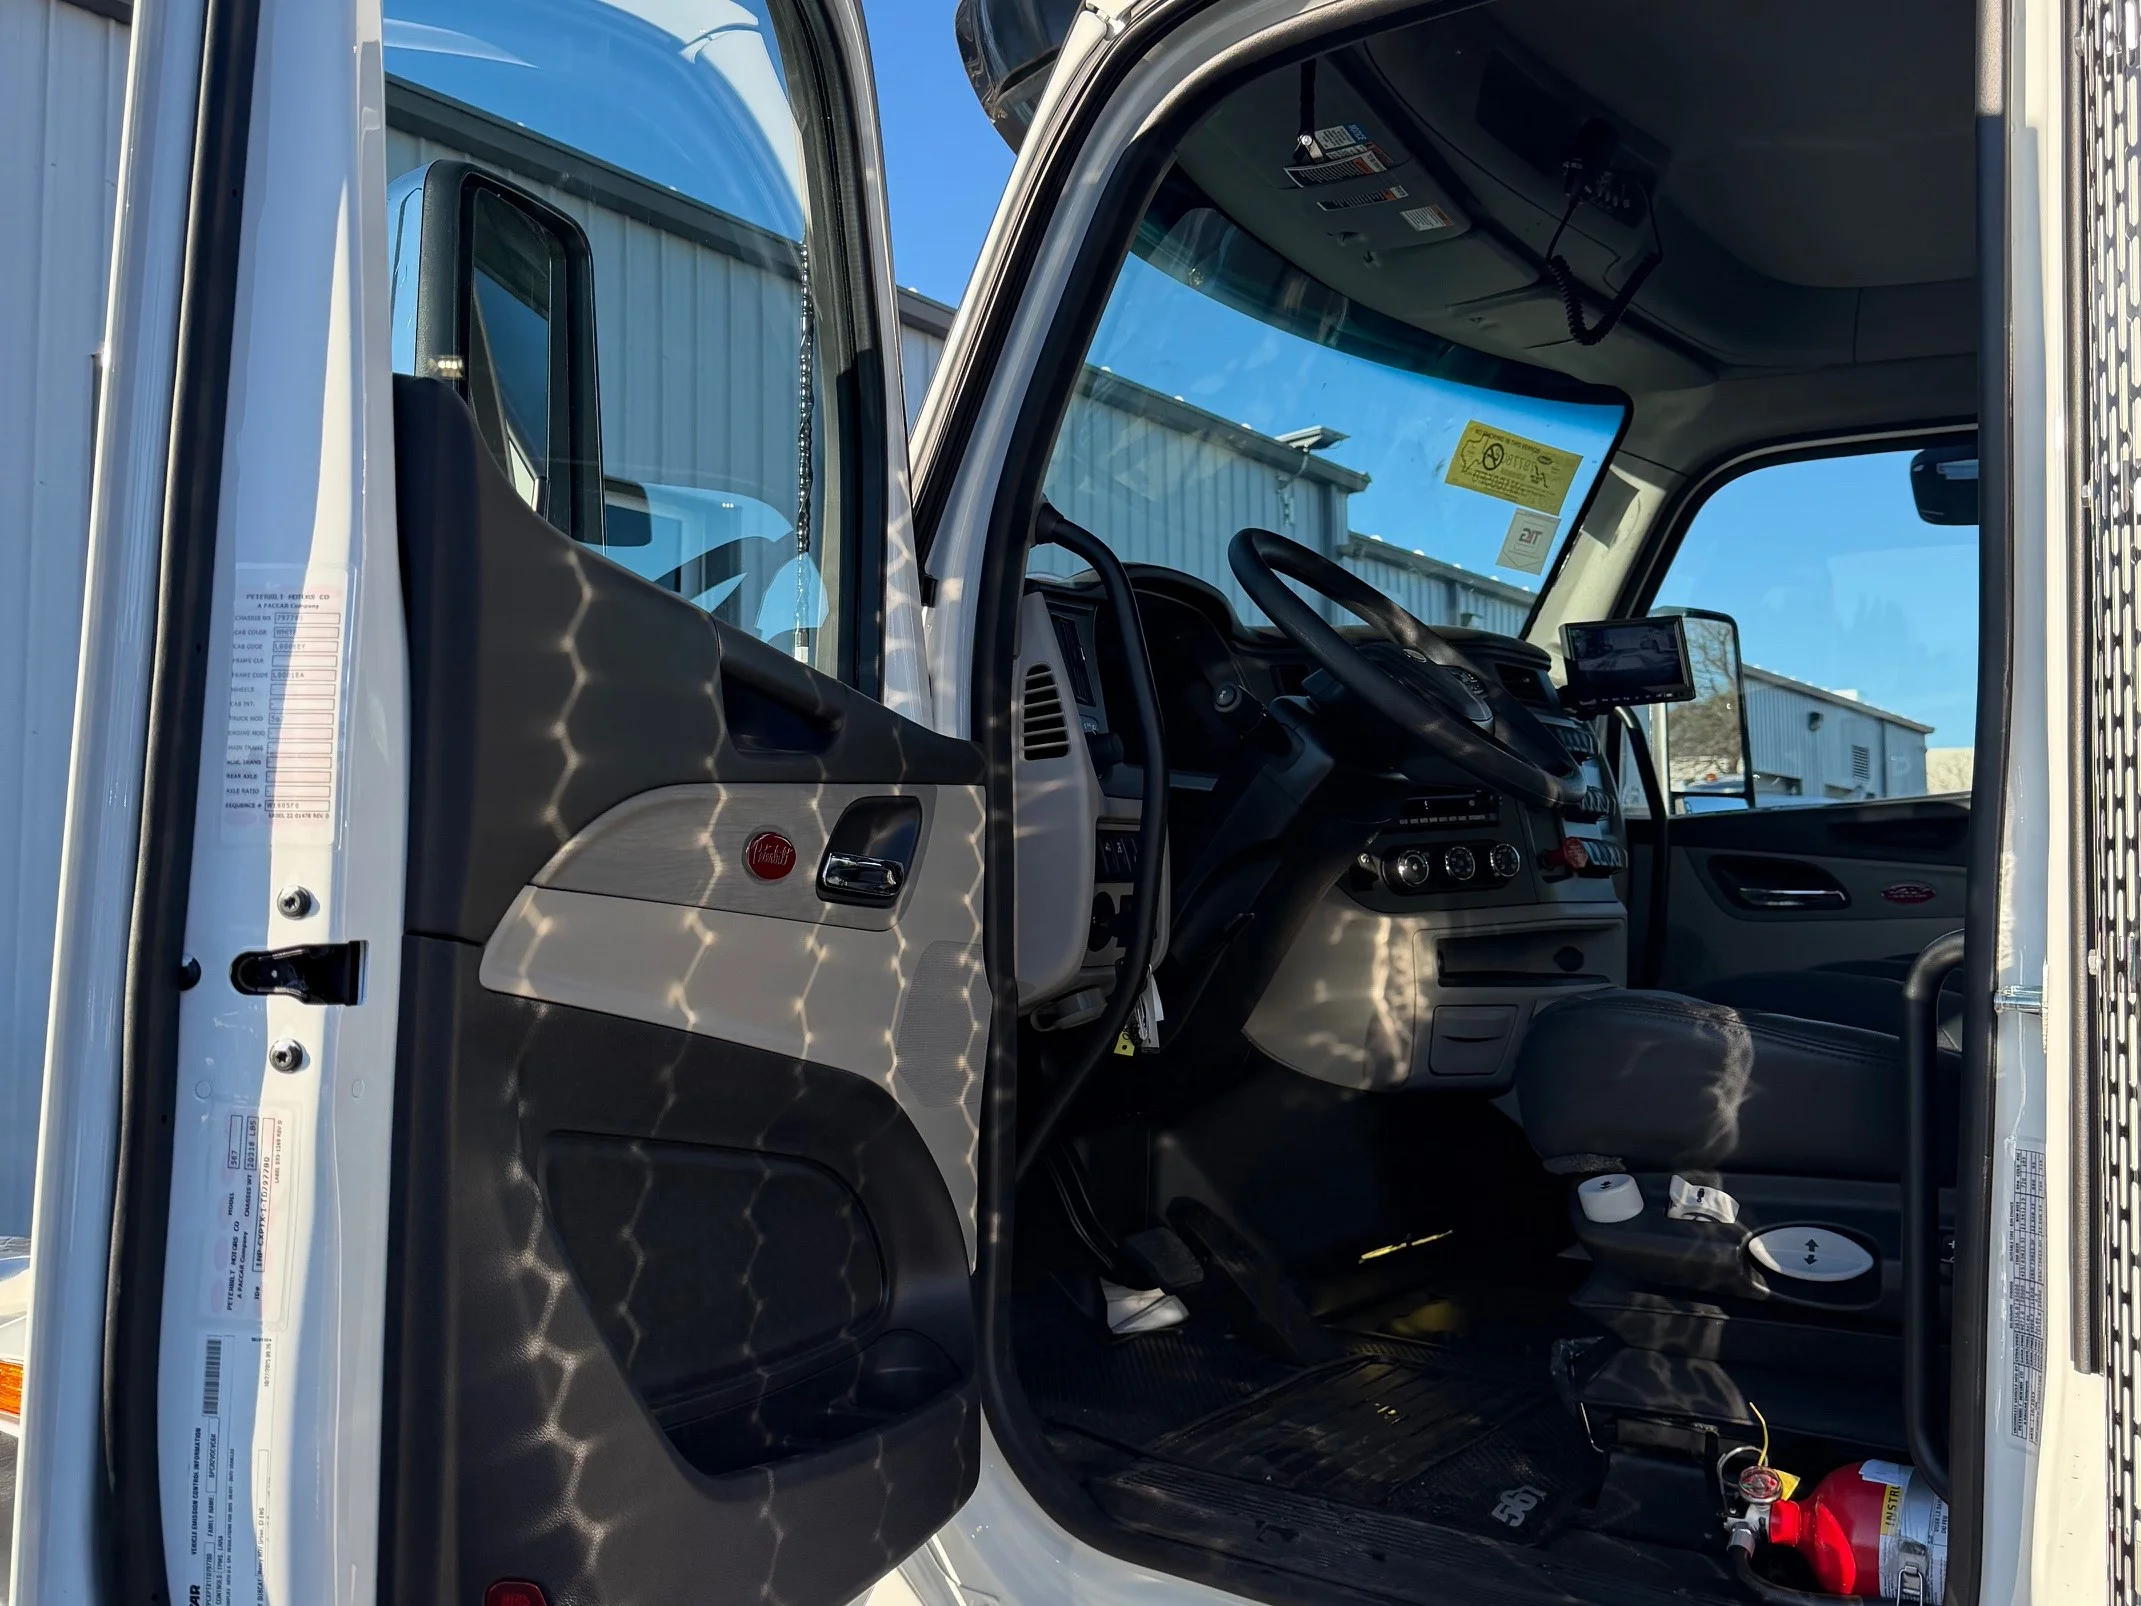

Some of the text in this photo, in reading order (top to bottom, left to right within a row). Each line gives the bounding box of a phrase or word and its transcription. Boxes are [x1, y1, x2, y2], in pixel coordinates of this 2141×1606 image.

[319, 593, 330, 601] CO
[248, 1120, 257, 1136] LBS
[246, 1173, 253, 1186] WT
[227, 1191, 235, 1217] MODEL
[244, 1186, 252, 1217] CHASSIS
[239, 1230, 249, 1263] Company
[226, 1220, 240, 1311] PETERBILT MOTORS CO
[237, 1264, 245, 1292] PACCAR
[190, 1427, 202, 1556] VEHICLE EMISSION CONTROL INFORMATION
[1491, 1486, 1547, 1527] 567
[207, 1516, 215, 1538] FAMILY
